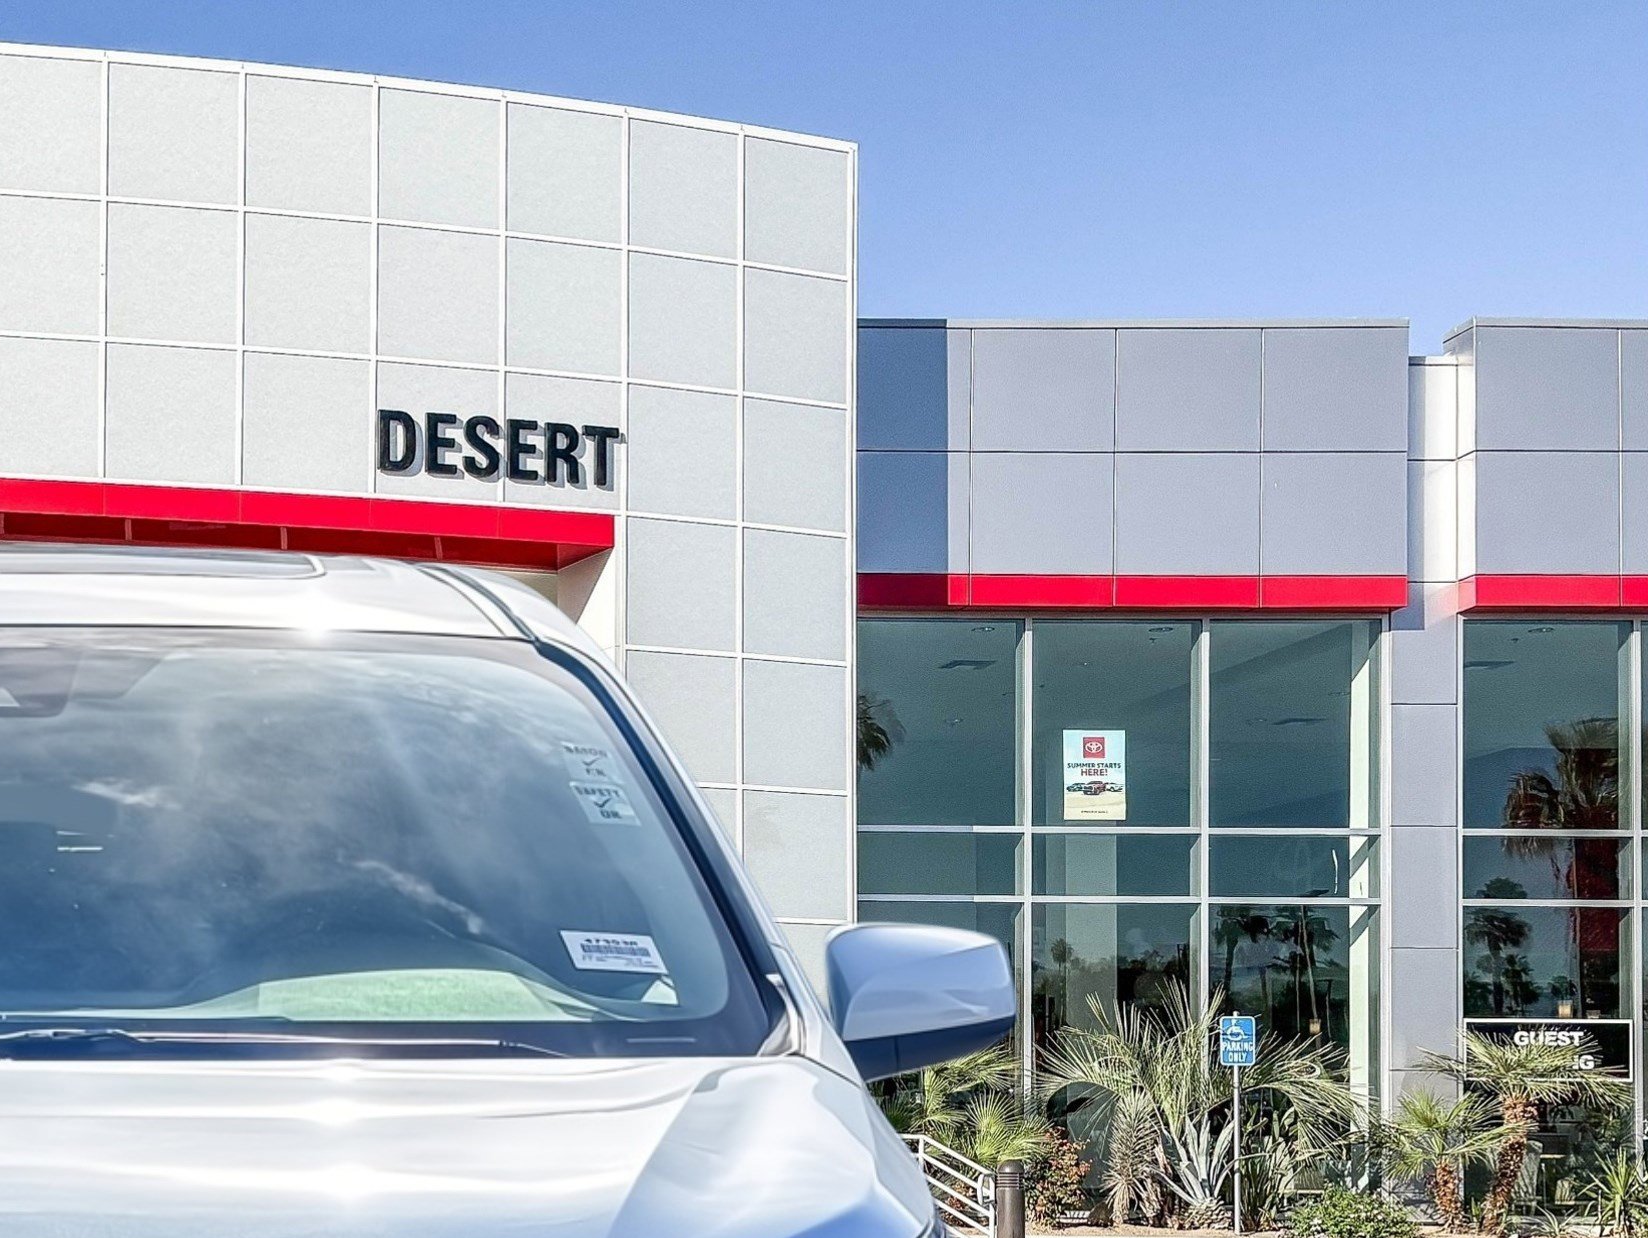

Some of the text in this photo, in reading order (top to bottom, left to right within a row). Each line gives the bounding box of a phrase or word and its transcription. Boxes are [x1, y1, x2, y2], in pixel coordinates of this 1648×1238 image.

[377, 409, 620, 487] DESERT
[1080, 768, 1108, 776] HERE!
[1513, 1030, 1584, 1047] GUEST
[1221, 1041, 1253, 1052] PARKING
[1228, 1051, 1248, 1063] ONLY
